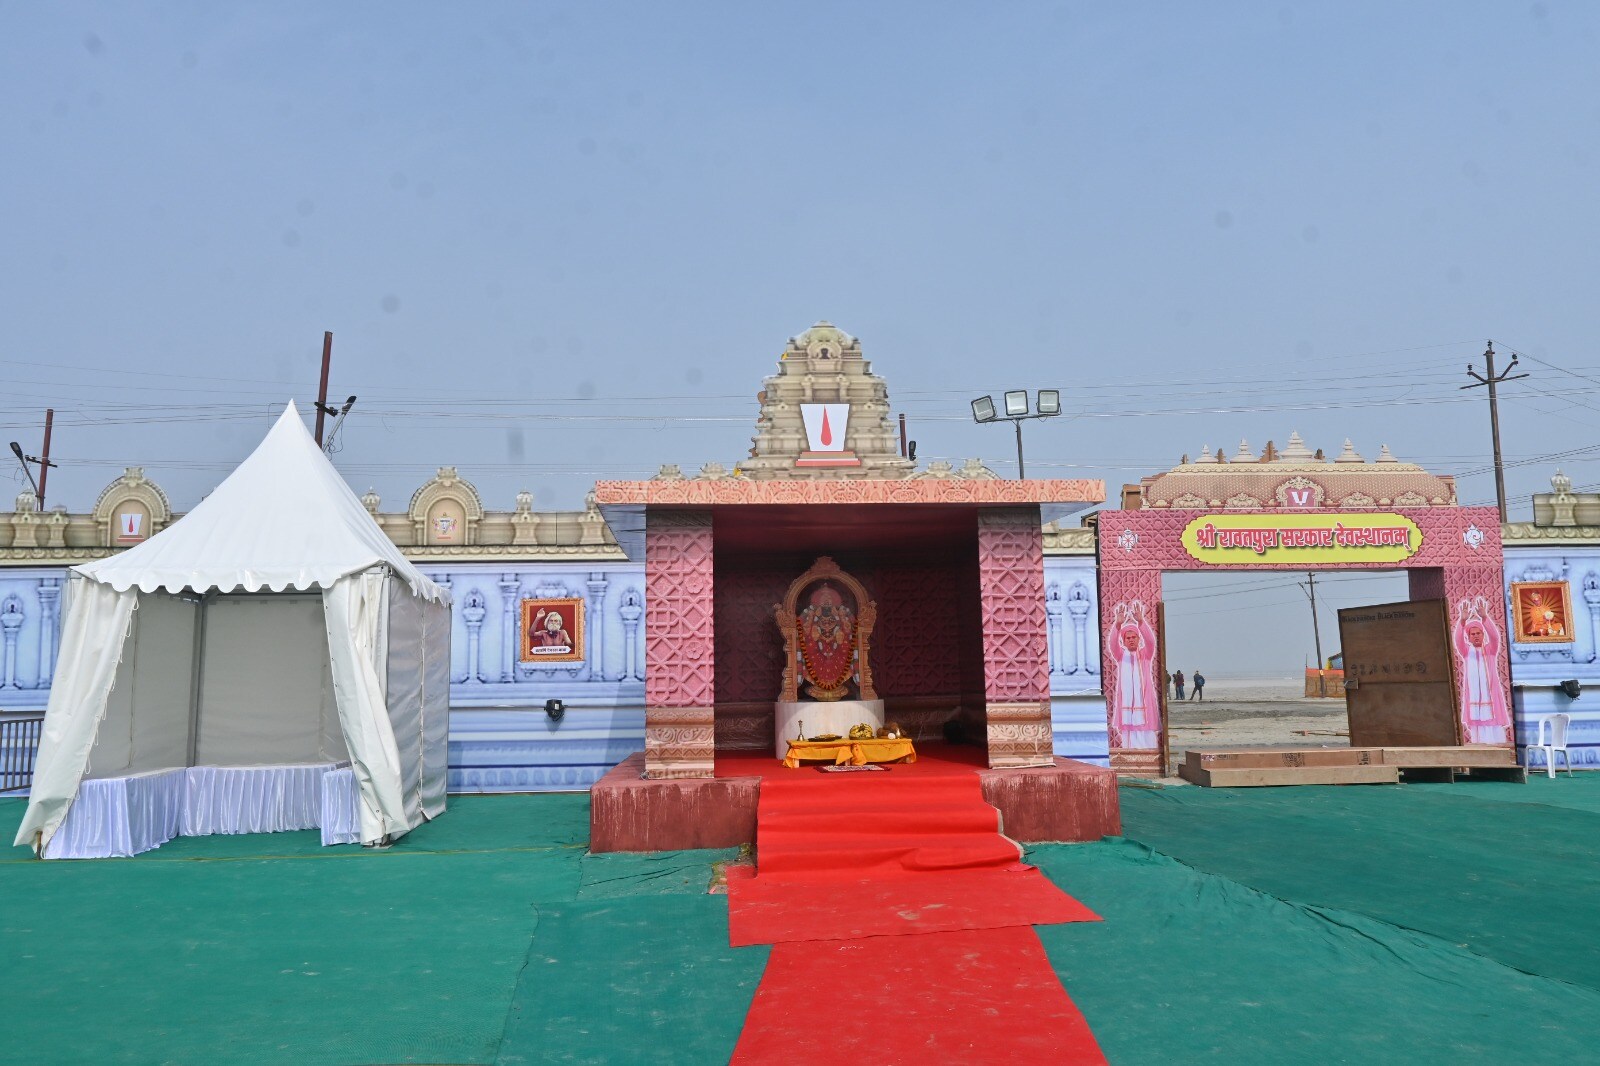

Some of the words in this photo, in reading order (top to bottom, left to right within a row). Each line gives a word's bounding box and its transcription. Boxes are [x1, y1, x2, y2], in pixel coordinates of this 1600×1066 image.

[1196, 522, 1216, 547] श्री
[1216, 528, 1277, 553] रावतपुरा
[1279, 527, 1332, 547] सरकार
[1334, 522, 1412, 550] देवस्थानम्
